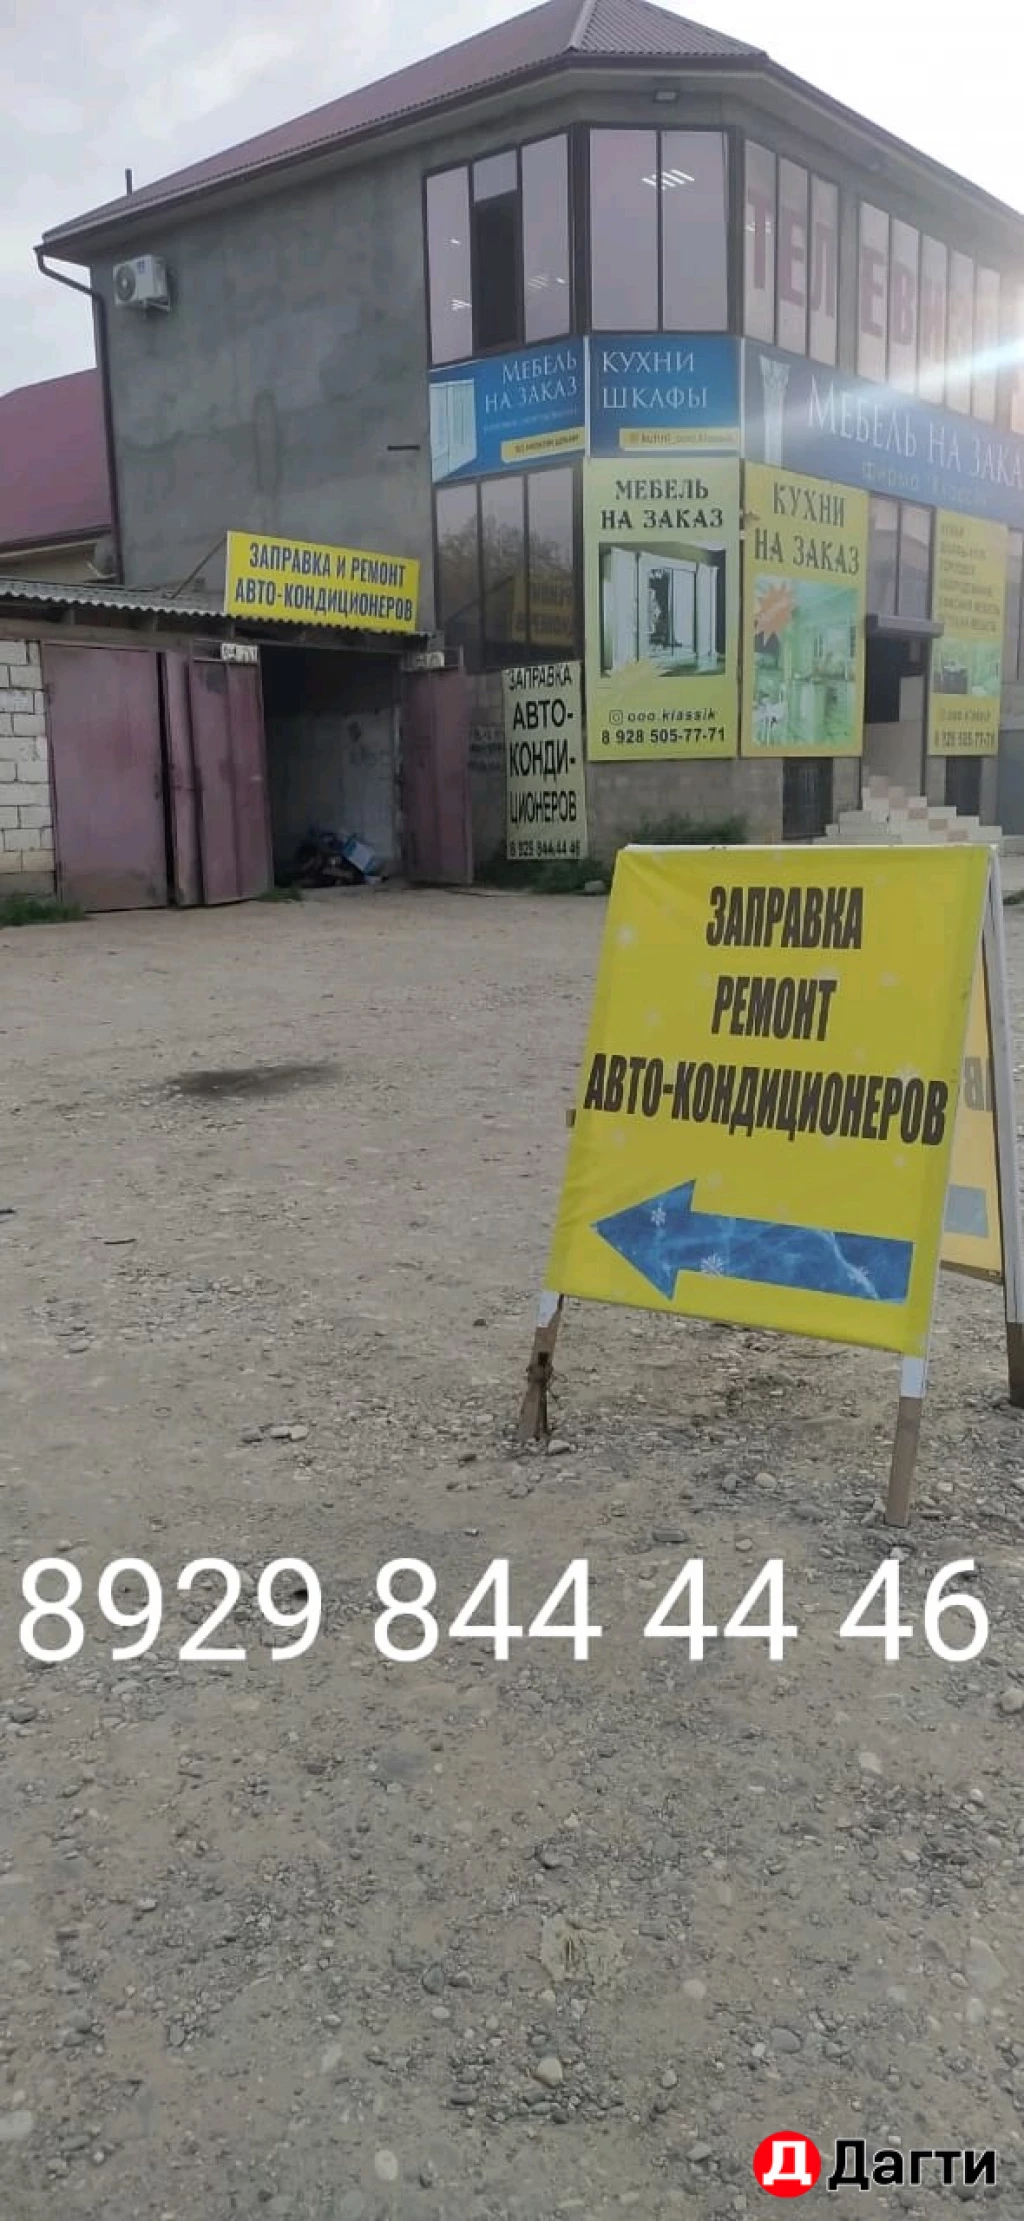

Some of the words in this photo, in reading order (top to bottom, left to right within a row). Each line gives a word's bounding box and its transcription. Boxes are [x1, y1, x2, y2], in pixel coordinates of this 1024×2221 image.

[503, 351, 577, 384] МЕБЕЛЬ
[603, 351, 695, 374] КУХНИ
[485, 393, 512, 414] НА
[518, 376, 577, 406] ЗАКАЗ
[603, 387, 708, 411] ШКАФЫ
[807, 374, 917, 458] МЕБЕЛЬ
[928, 421, 962, 473] НА
[970, 436, 1024, 492] ЗАКА
[615, 479, 709, 501] МЕБЕЛЬ
[773, 481, 845, 528] КУХНИ
[601, 508, 632, 530] НА
[643, 508, 724, 529] ЗАКАЗ
[249, 542, 331, 577] ЗАПРАВКА
[336, 554, 347, 579] И
[350, 556, 406, 588] РЕМОНТ
[755, 527, 784, 564] НА
[792, 535, 860, 576] ЗАКАЗ
[234, 576, 413, 622] АВТО-КОНДИЦИОНЕРОВ
[509, 665, 573, 690] ЗАПРАВКА
[513, 698, 574, 731] АВТО-
[627, 710, 716, 723] ooo.klassik
[601, 731, 610, 745] 8
[616, 729, 644, 744] 928
[650, 727, 726, 744] 505-77-71
[509, 738, 576, 782] КОНДИ-
[509, 790, 577, 829] ЦИОНЕРОВ
[706, 886, 864, 950] ЗАПРАВКА
[711, 976, 837, 1042] РЕМОНТ
[583, 1053, 948, 1146] АВТО-КОНДИЦИОНЕРОВ
